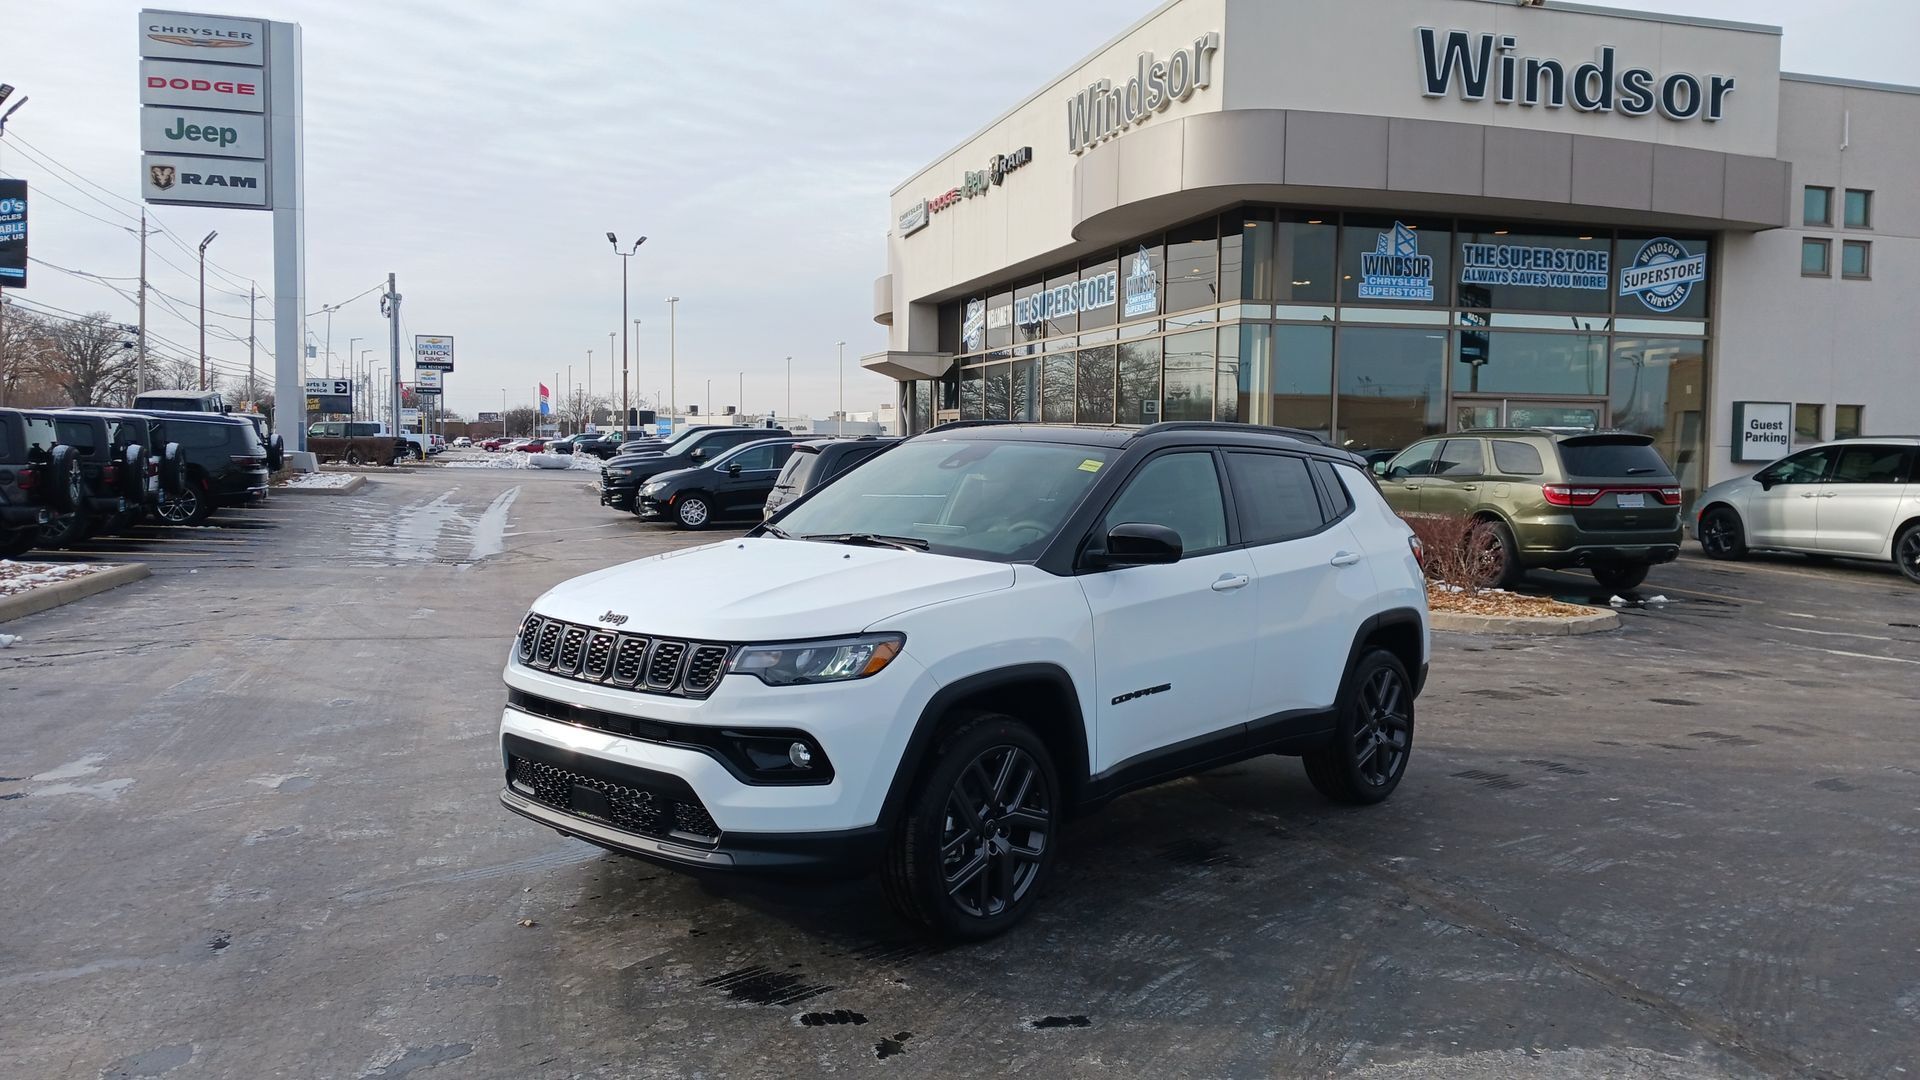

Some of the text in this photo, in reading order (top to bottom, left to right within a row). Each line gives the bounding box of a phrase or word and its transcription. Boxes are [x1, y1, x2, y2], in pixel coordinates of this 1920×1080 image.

[148, 25, 253, 40] CHRYSLER
[1416, 26, 1737, 121] Windsor
[147, 76, 256, 96] DODGE
[1066, 31, 1219, 155] Windsor
[164, 117, 238, 148] Jeep
[181, 172, 257, 189] RAM
[899, 202, 923, 222] CHRYSLER
[928, 186, 961, 213] DODGE
[999, 146, 1033, 174] RAM
[0, 213, 22, 221] CLES
[0, 222, 25, 234] ABLE
[1463, 245, 1607, 271] THE SUPERSTORE
[1640, 242, 1680, 263] WINDSOR
[1364, 255, 1430, 277] WINDSOR
[1623, 262, 1702, 288] SUPERSTORE
[1127, 273, 1155, 297] WINDSOR
[1369, 277, 1424, 287] CHRYSLER
[1463, 269, 1607, 288] ALWAYS SAVES YOU MORE!
[1015, 300, 1029, 324] THE
[1031, 273, 1115, 321] SUPERSTORE
[1360, 286, 1431, 297] SUPERSTORE
[1645, 285, 1686, 307] CHRYSLER
[1750, 418, 1783, 430] Guest
[1745, 431, 1788, 445] Parking
[599, 610, 629, 627] Jeep
[1111, 682, 1172, 706] COMPASS
